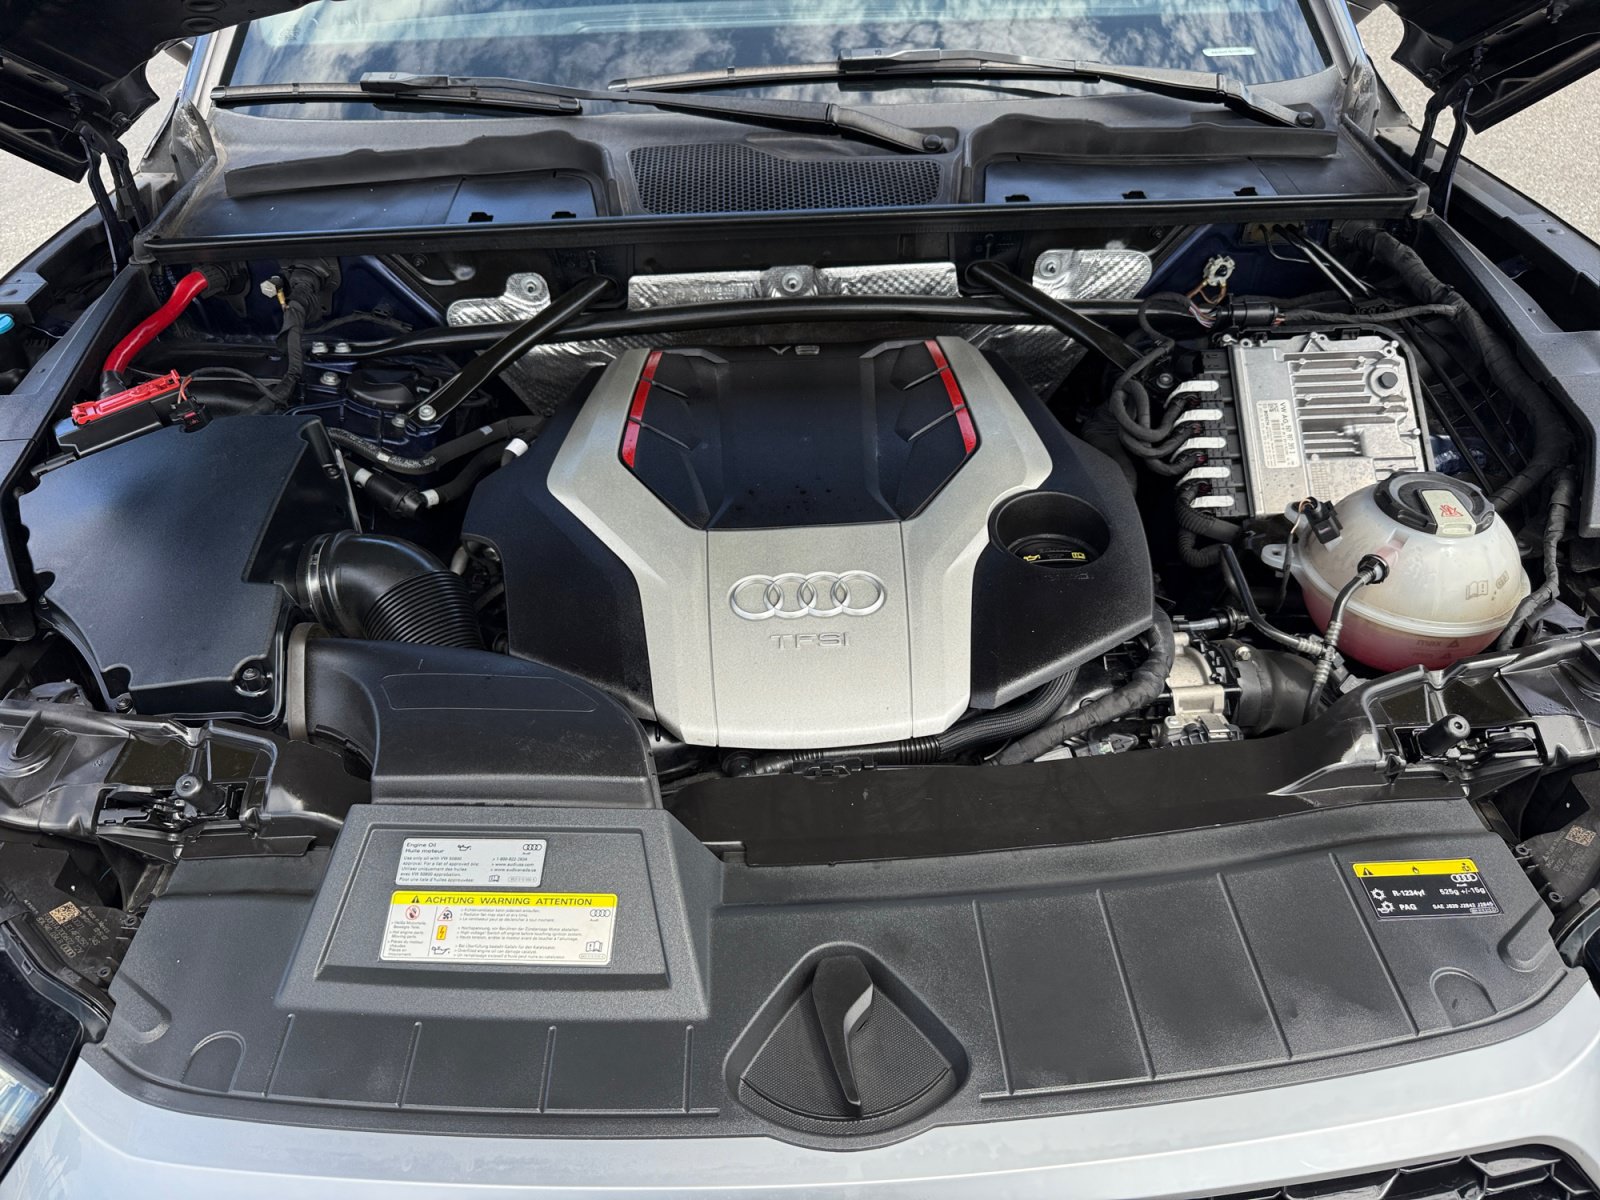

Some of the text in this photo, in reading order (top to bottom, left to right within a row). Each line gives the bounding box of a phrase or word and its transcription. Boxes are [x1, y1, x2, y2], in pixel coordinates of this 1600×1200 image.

[769, 632, 849, 650] TFSI
[1391, 887, 1486, 898] R-1234yf 525g +/-15g
[425, 896, 593, 906] ACHTUNG WARNING ATTENTION
[1398, 903, 1418, 911] PAG
